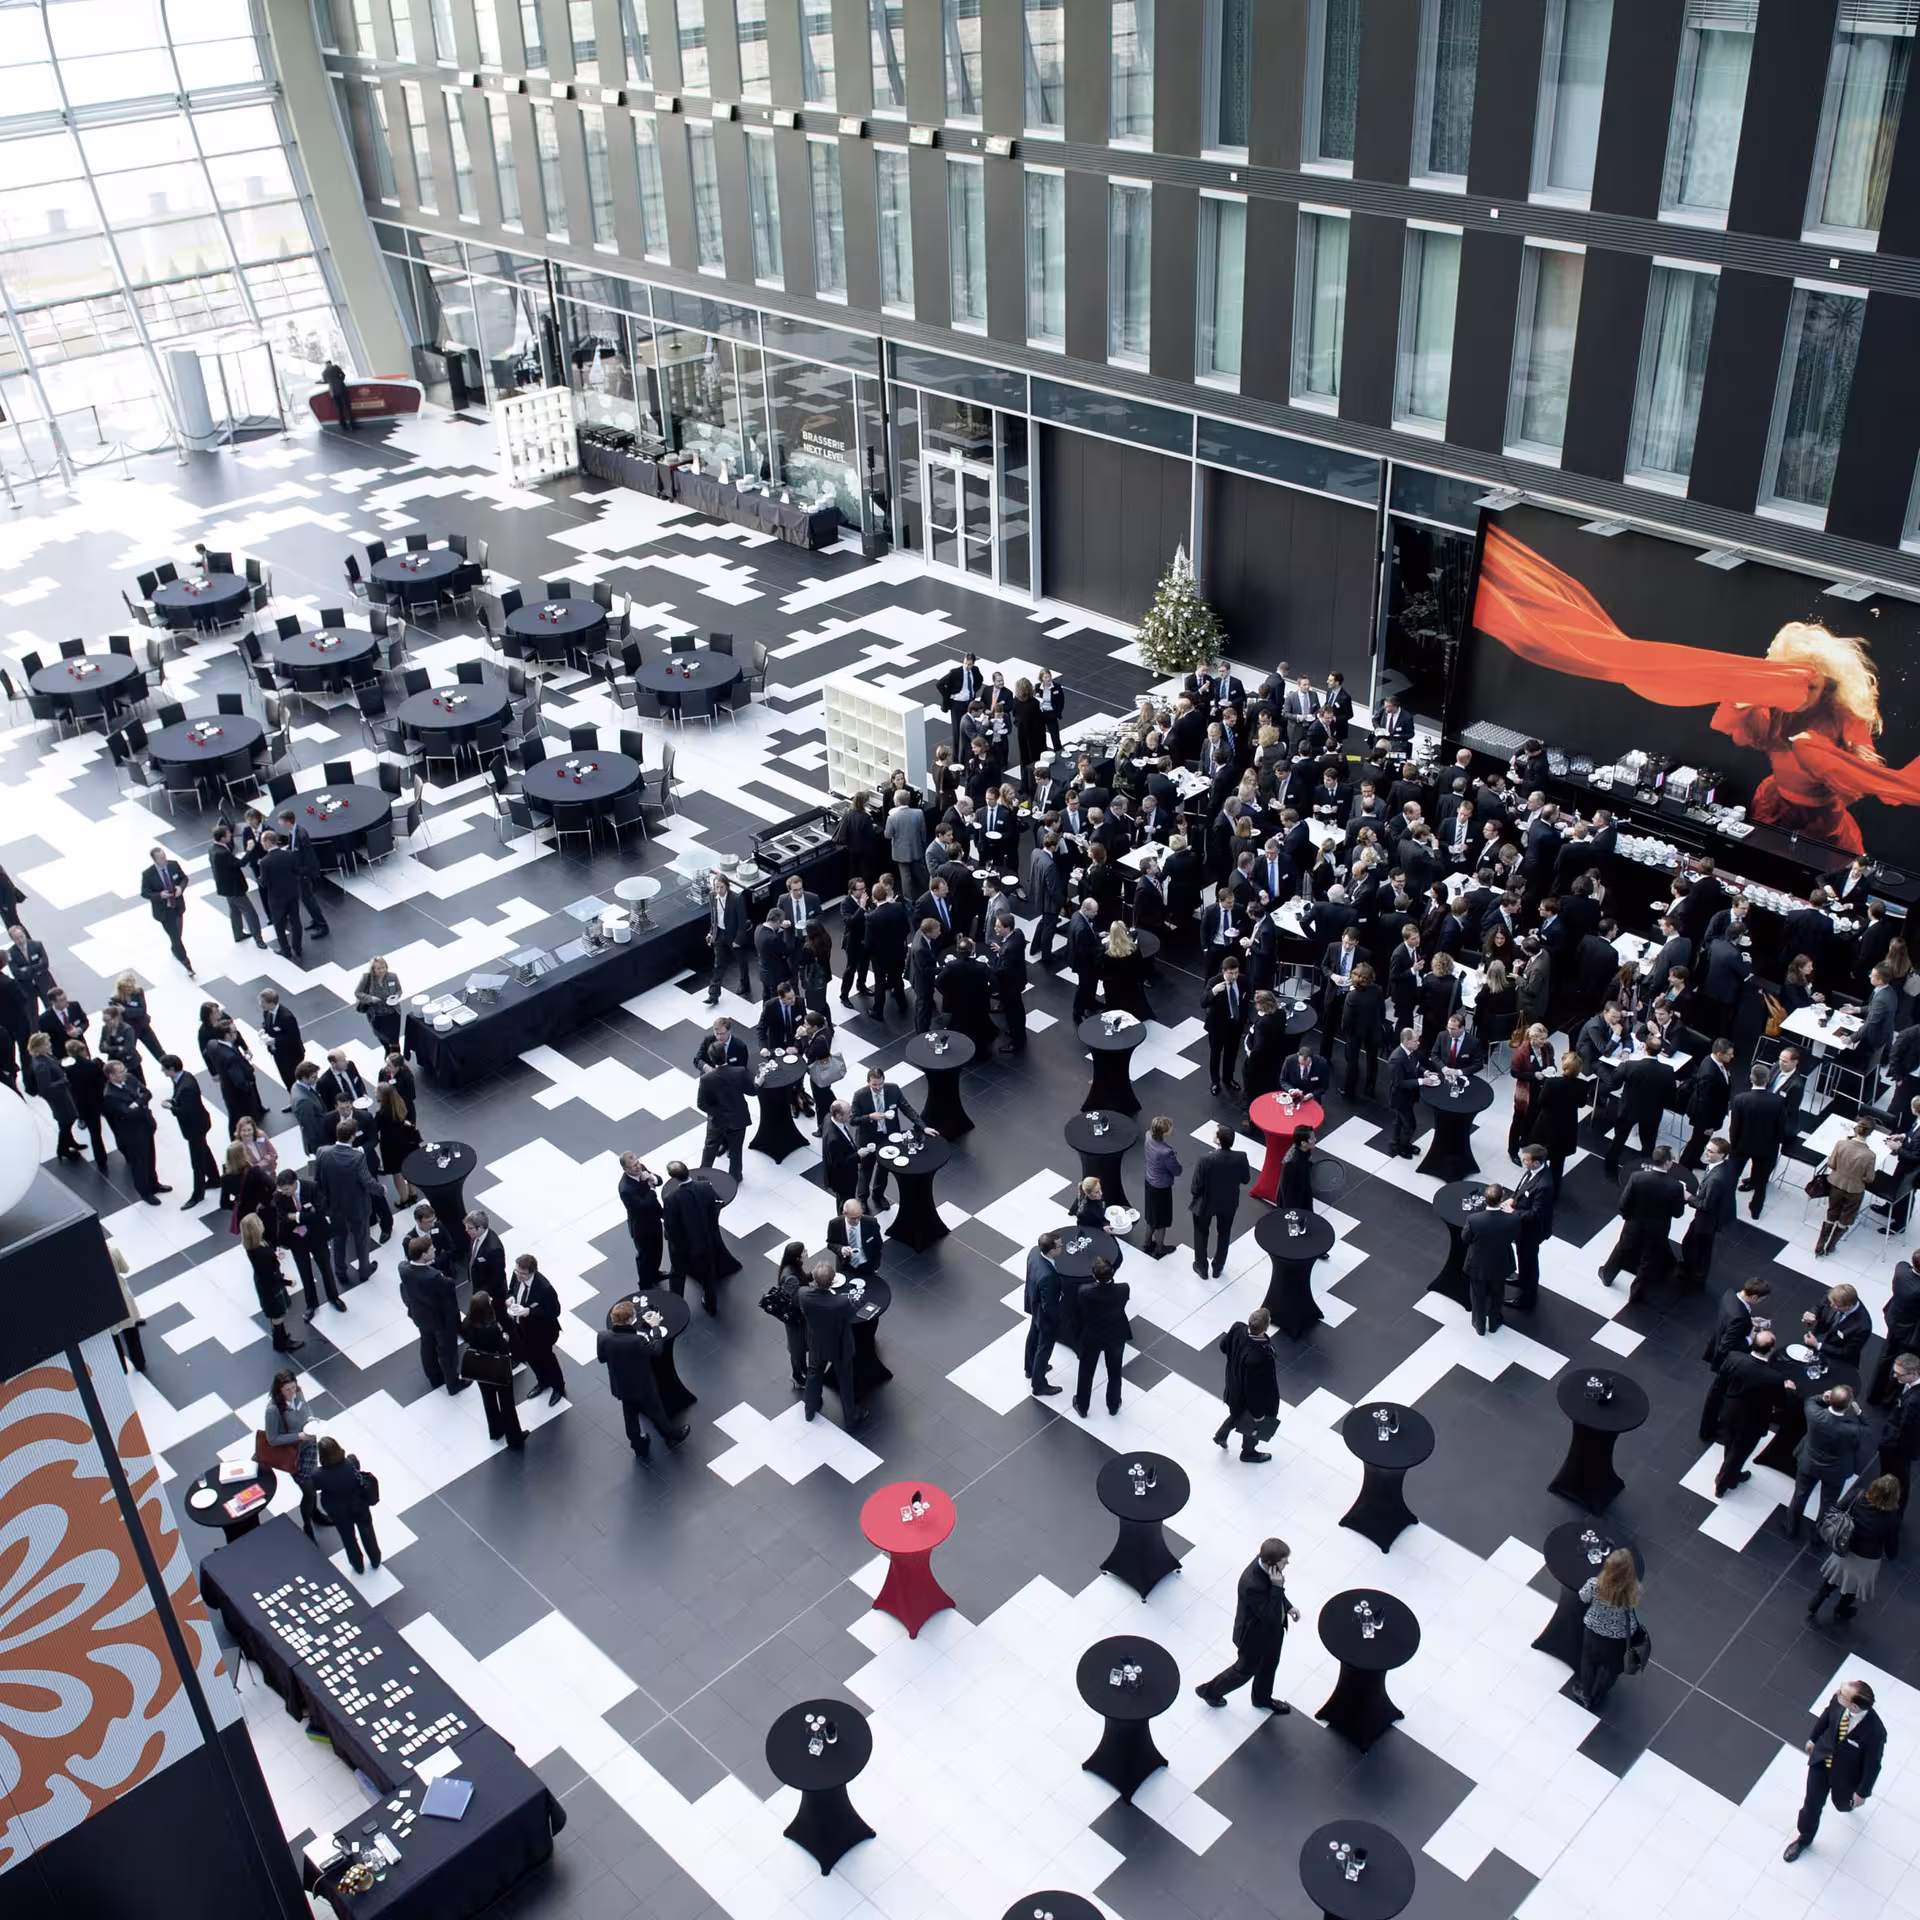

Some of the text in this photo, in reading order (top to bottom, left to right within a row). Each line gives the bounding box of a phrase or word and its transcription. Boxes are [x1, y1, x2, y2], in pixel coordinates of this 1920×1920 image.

[803, 431, 846, 451] BRASSERIE
[803, 443, 846, 464] NEXT LEVEL
